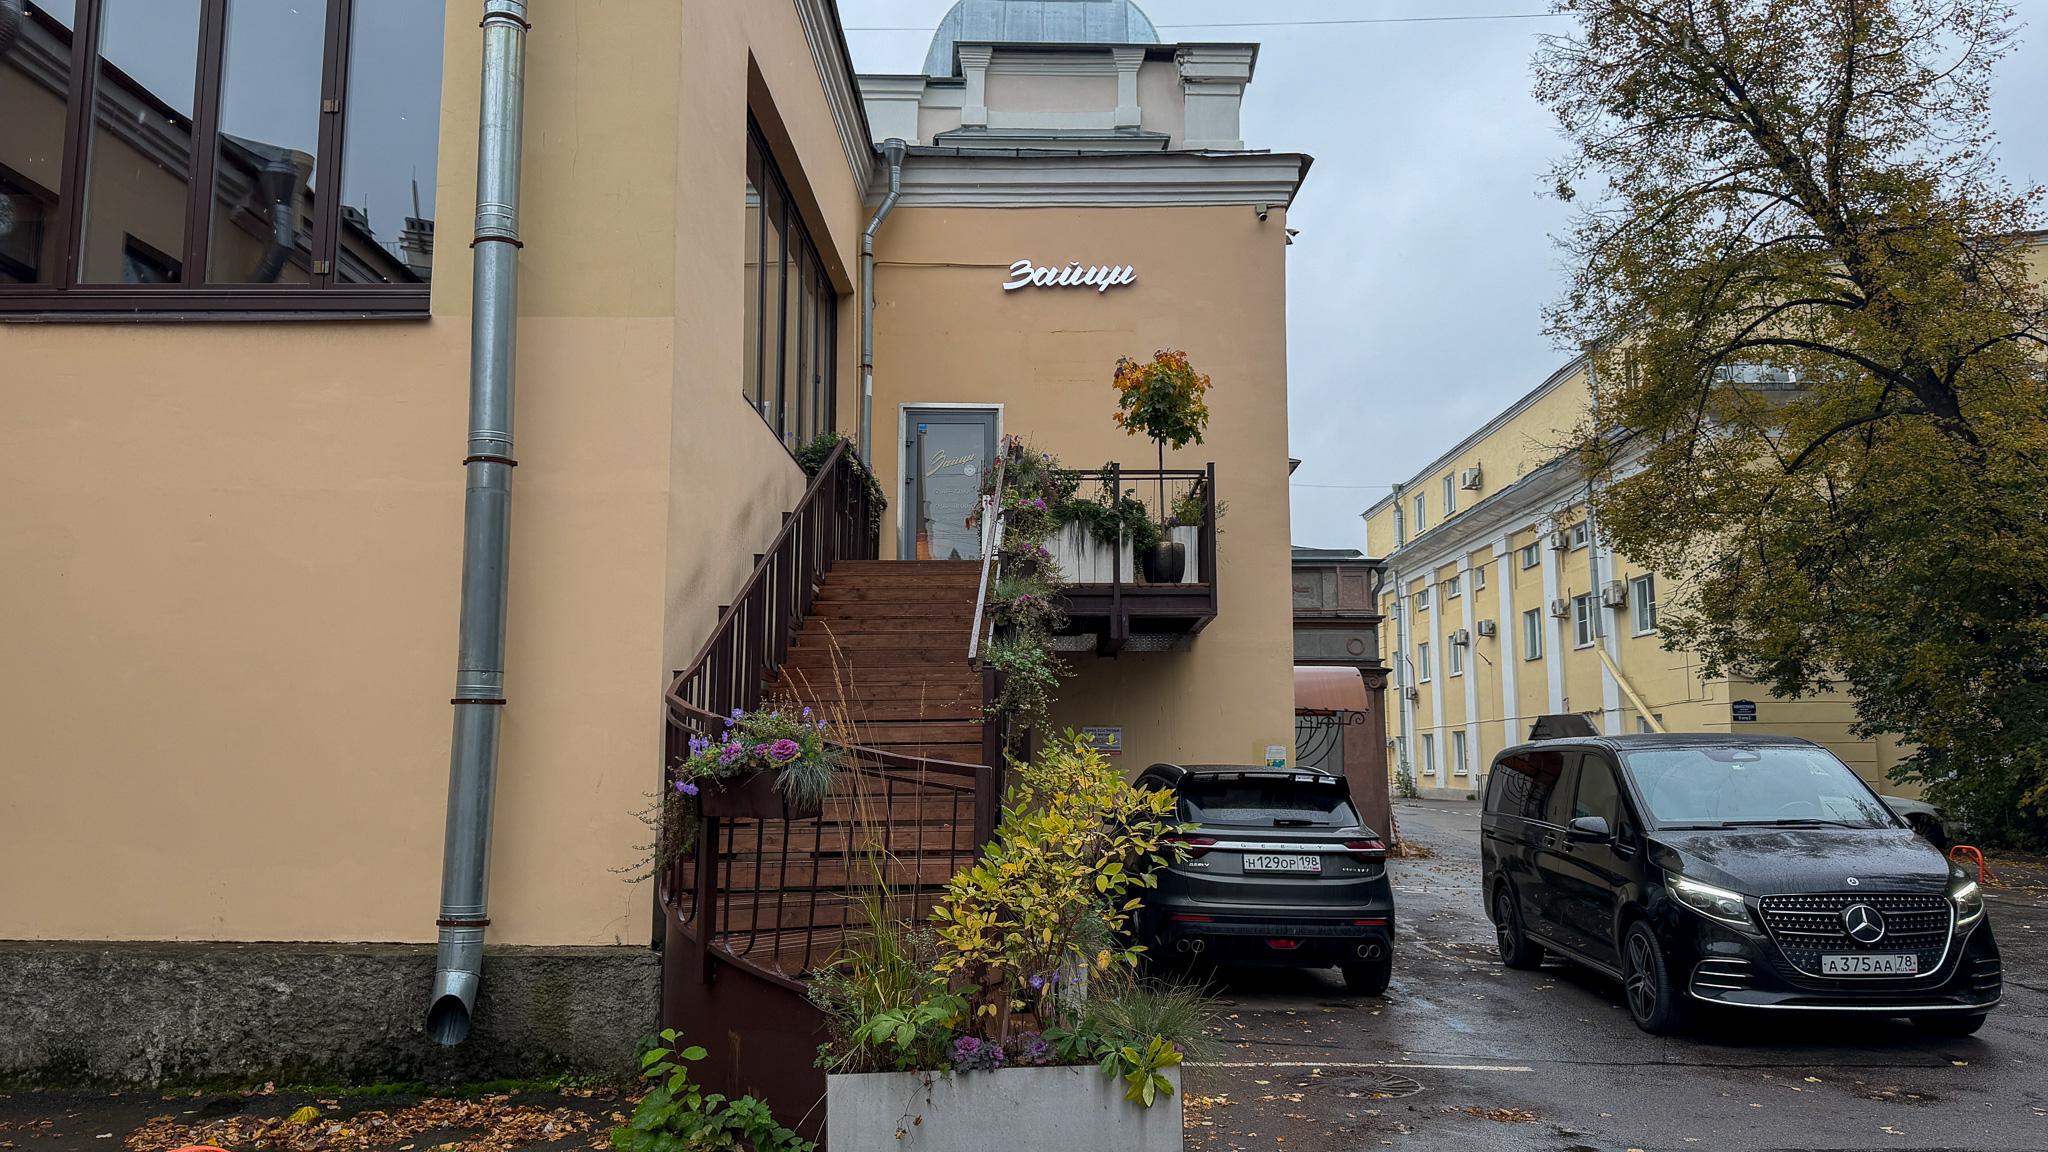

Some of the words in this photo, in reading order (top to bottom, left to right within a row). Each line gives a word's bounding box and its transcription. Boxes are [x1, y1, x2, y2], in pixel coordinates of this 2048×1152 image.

[1003, 259, 1138, 293] Зайцы
[925, 449, 976, 478] Зайцы
[1248, 856, 1296, 869] Н129ОР
[1299, 856, 1318, 866] 198
[1829, 957, 1893, 972] А375АА
[1897, 956, 1912, 967] 78
